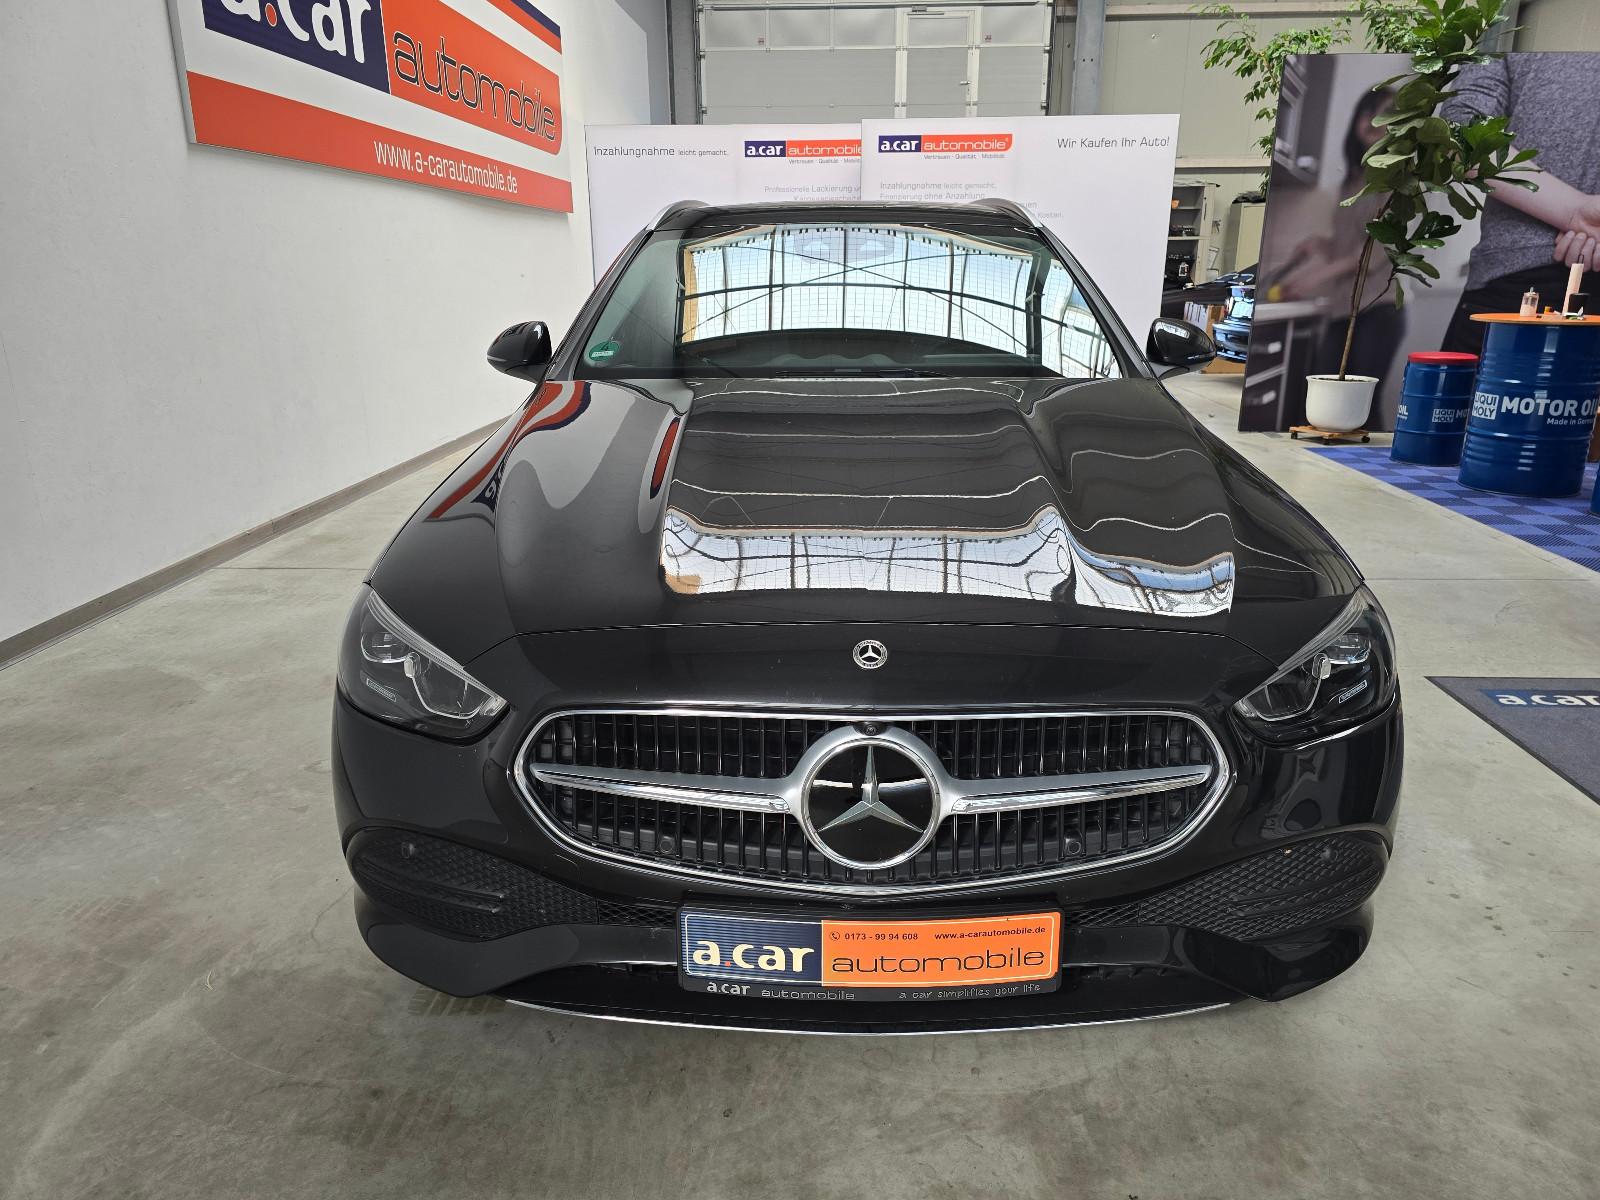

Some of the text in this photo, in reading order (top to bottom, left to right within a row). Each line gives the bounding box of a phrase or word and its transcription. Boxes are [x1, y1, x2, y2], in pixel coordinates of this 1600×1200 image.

[392, 31, 556, 141] automobile
[881, 140, 920, 151] a.car
[1057, 136, 1170, 148] Wir Kaufen Ihr Auto!
[594, 147, 675, 158] Inzahlungnahme
[698, 149, 729, 157] gemacht.
[746, 145, 784, 156] a.car
[374, 140, 518, 195] www.a-carautomobile.de
[811, 184, 853, 193] Lackierung
[880, 182, 942, 190] Inzahlungnahme
[1475, 393, 1497, 406] LIQUI
[1501, 396, 1577, 416] MOTOR
[1473, 405, 1495, 418] MOLY
[934, 926, 1046, 940] www.a-carautomobile.de
[692, 940, 1045, 973] a.car automobile
[706, 981, 751, 996] a.car
[761, 989, 855, 1000] automobile
[994, 986, 1019, 997] your
